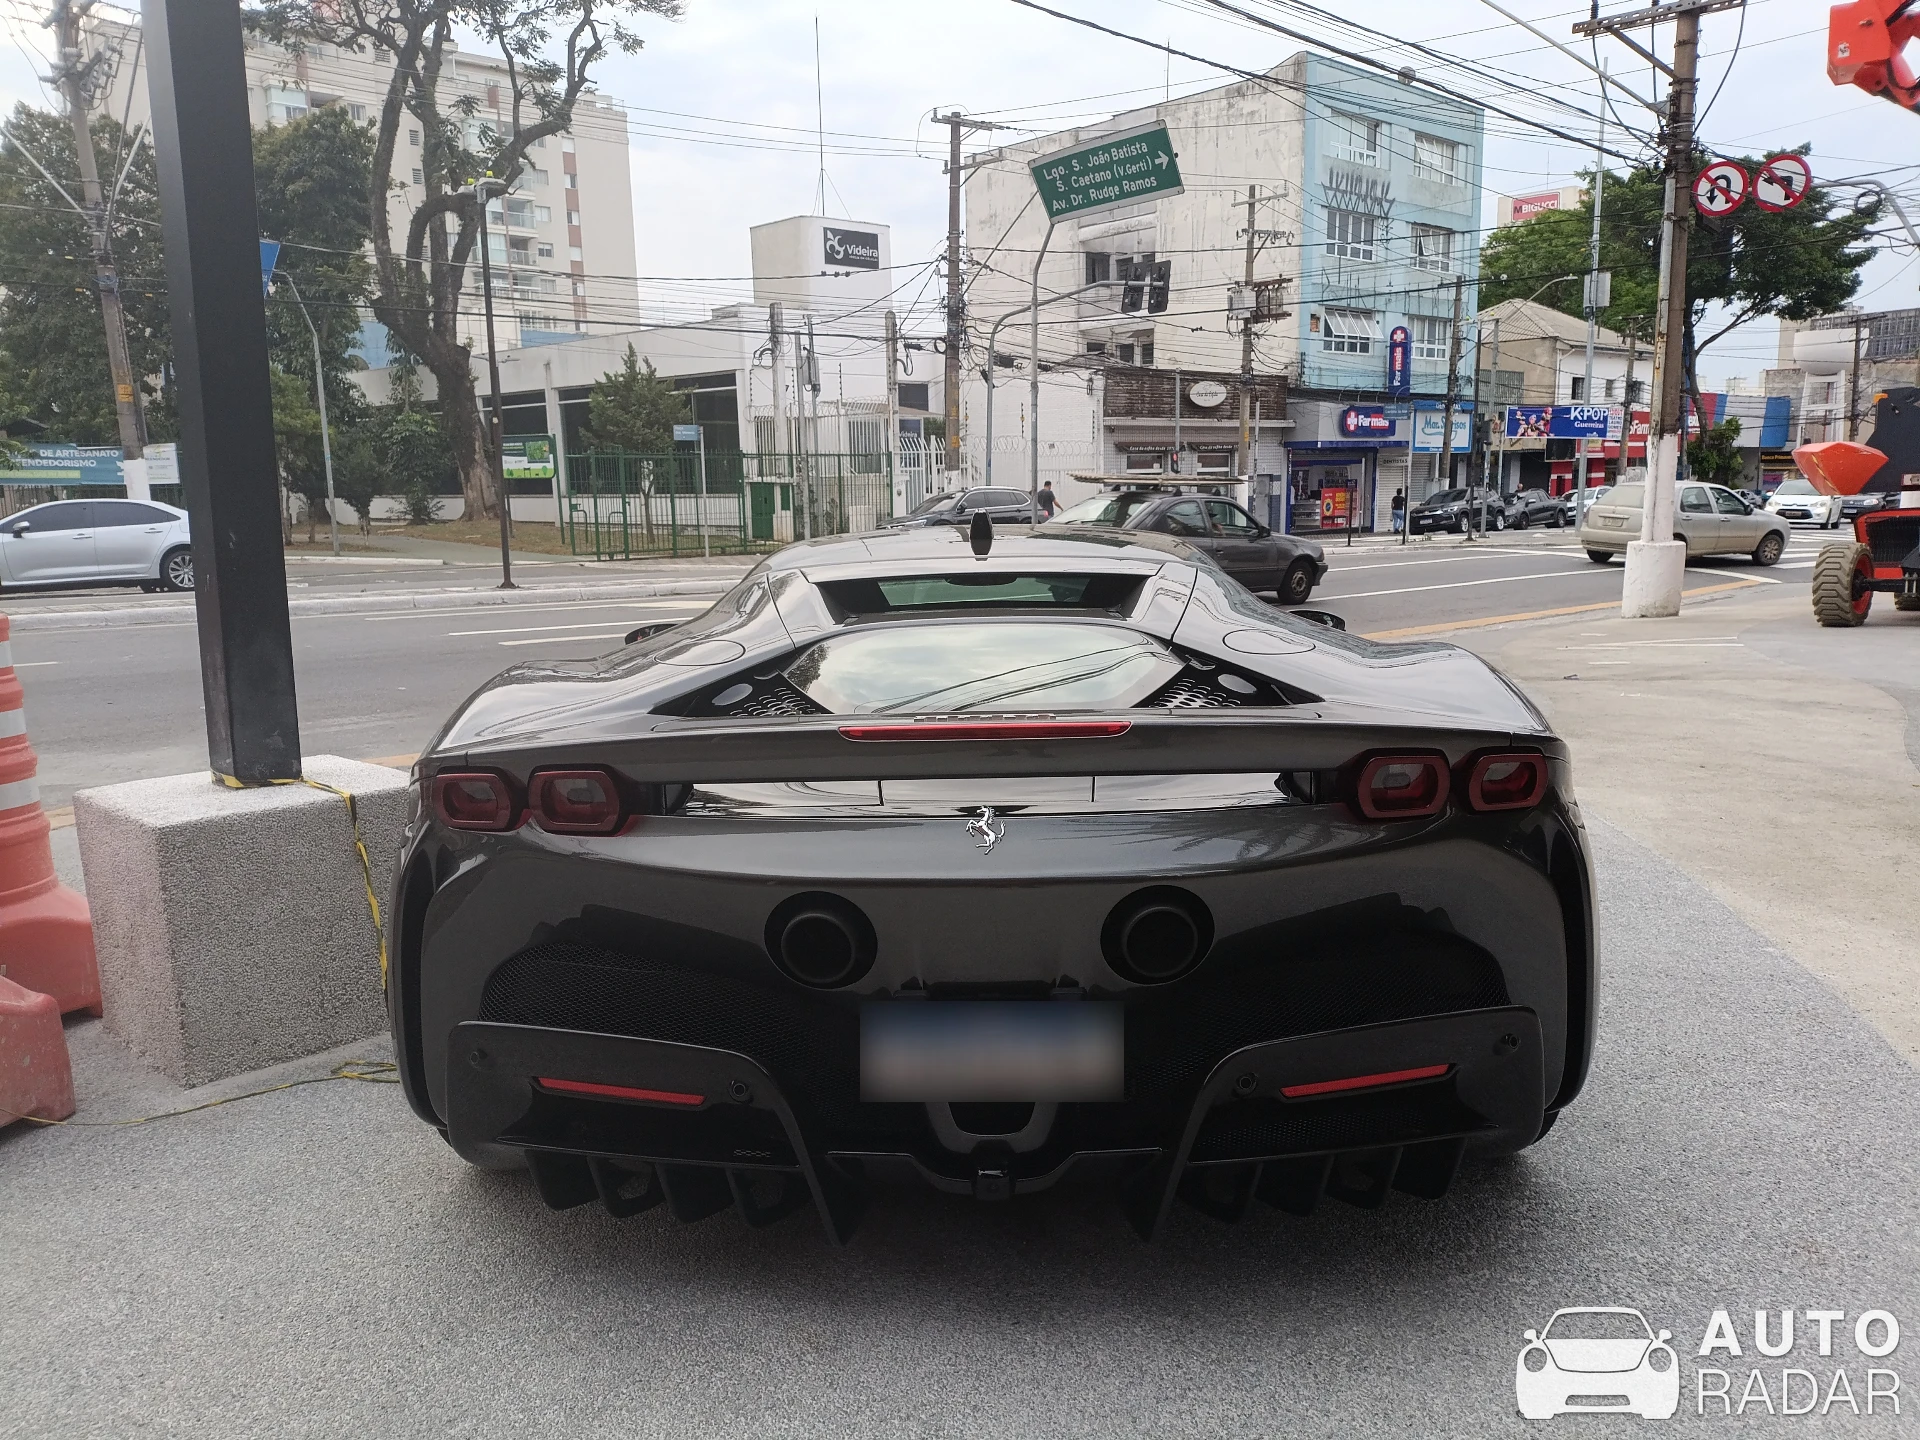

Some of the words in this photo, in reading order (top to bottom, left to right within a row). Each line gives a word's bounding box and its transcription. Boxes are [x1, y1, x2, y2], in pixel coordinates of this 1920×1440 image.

[1043, 166, 1069, 181] Lgo.
[1072, 159, 1083, 171] S.
[1111, 141, 1148, 160] Batista
[1056, 180, 1068, 192] S.
[1071, 170, 1112, 188] Caetano
[1052, 199, 1070, 211] Av.
[1070, 193, 1087, 206] Dr.
[1089, 185, 1120, 201] Rudge
[1122, 176, 1157, 193] Ramos
[1514, 200, 1557, 213] MBIGUCCI
[846, 244, 878, 257] Videira
[1393, 347, 1402, 386] Farmais
[1358, 413, 1389, 427] Farmais
[55, 449, 119, 458] ARTESANATO
